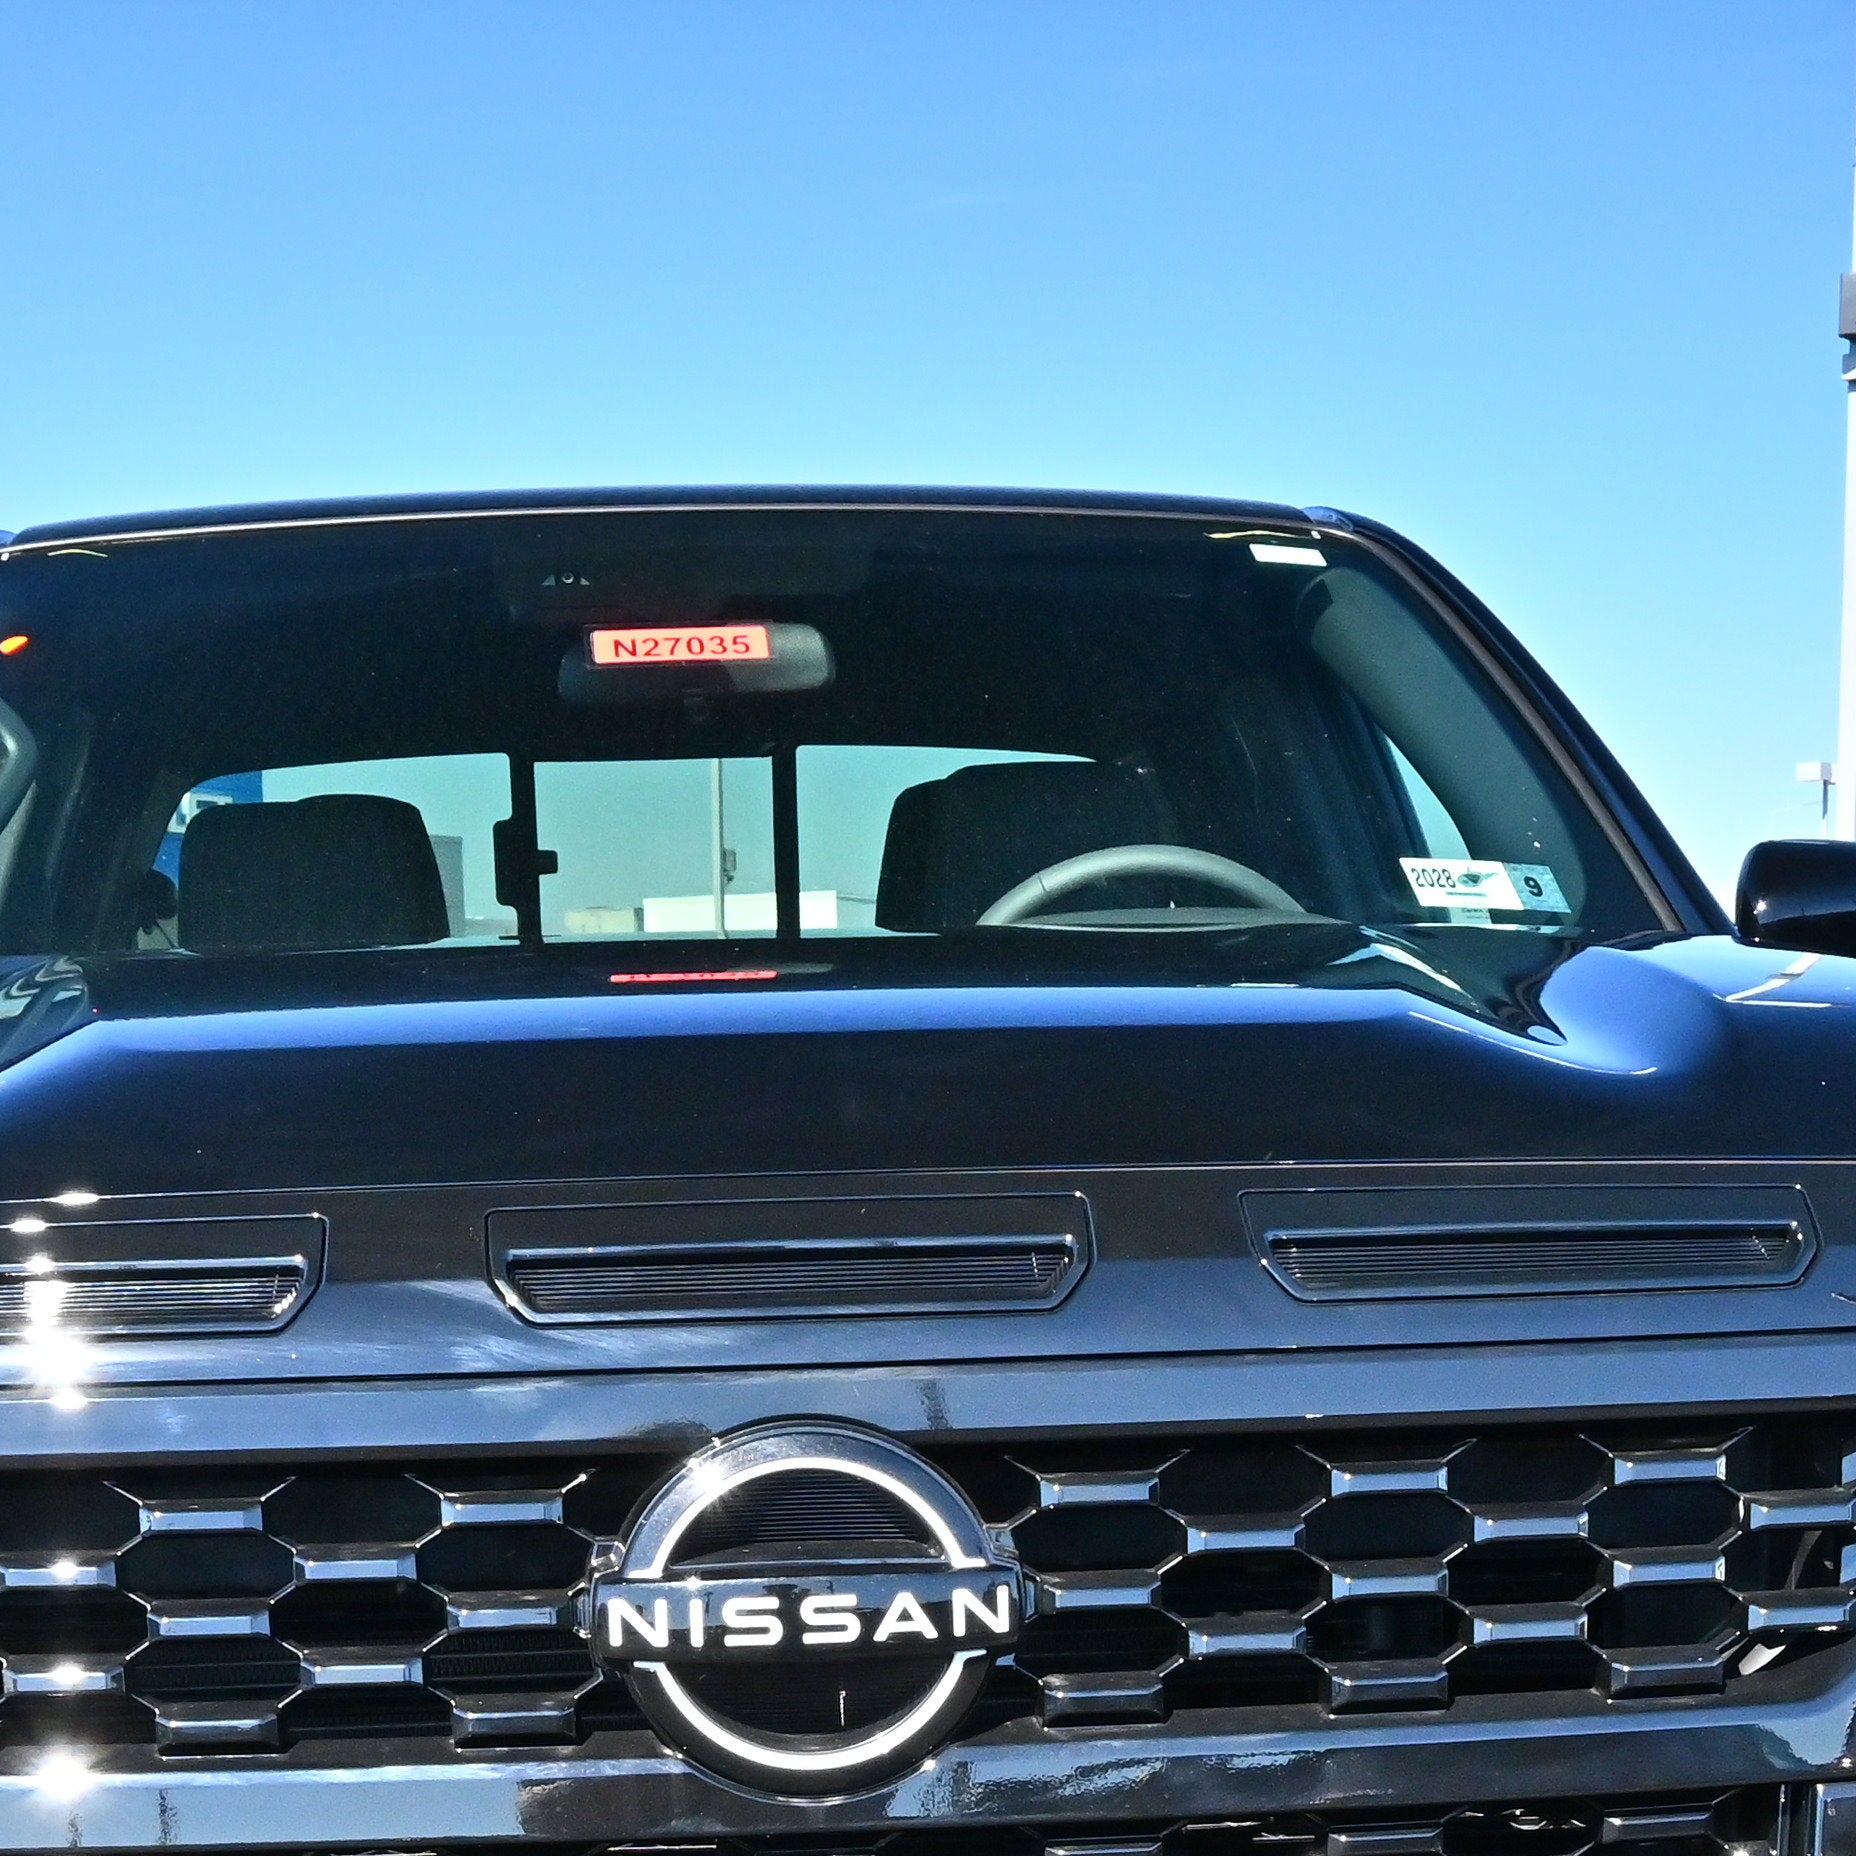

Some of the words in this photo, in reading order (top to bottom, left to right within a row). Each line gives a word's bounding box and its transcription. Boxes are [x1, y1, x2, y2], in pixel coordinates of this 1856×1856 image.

[613, 635, 750, 658] N27035
[1411, 868, 1456, 888] 2028
[1523, 875, 1543, 898] 9
[607, 1585, 1011, 1649] NISSAN
